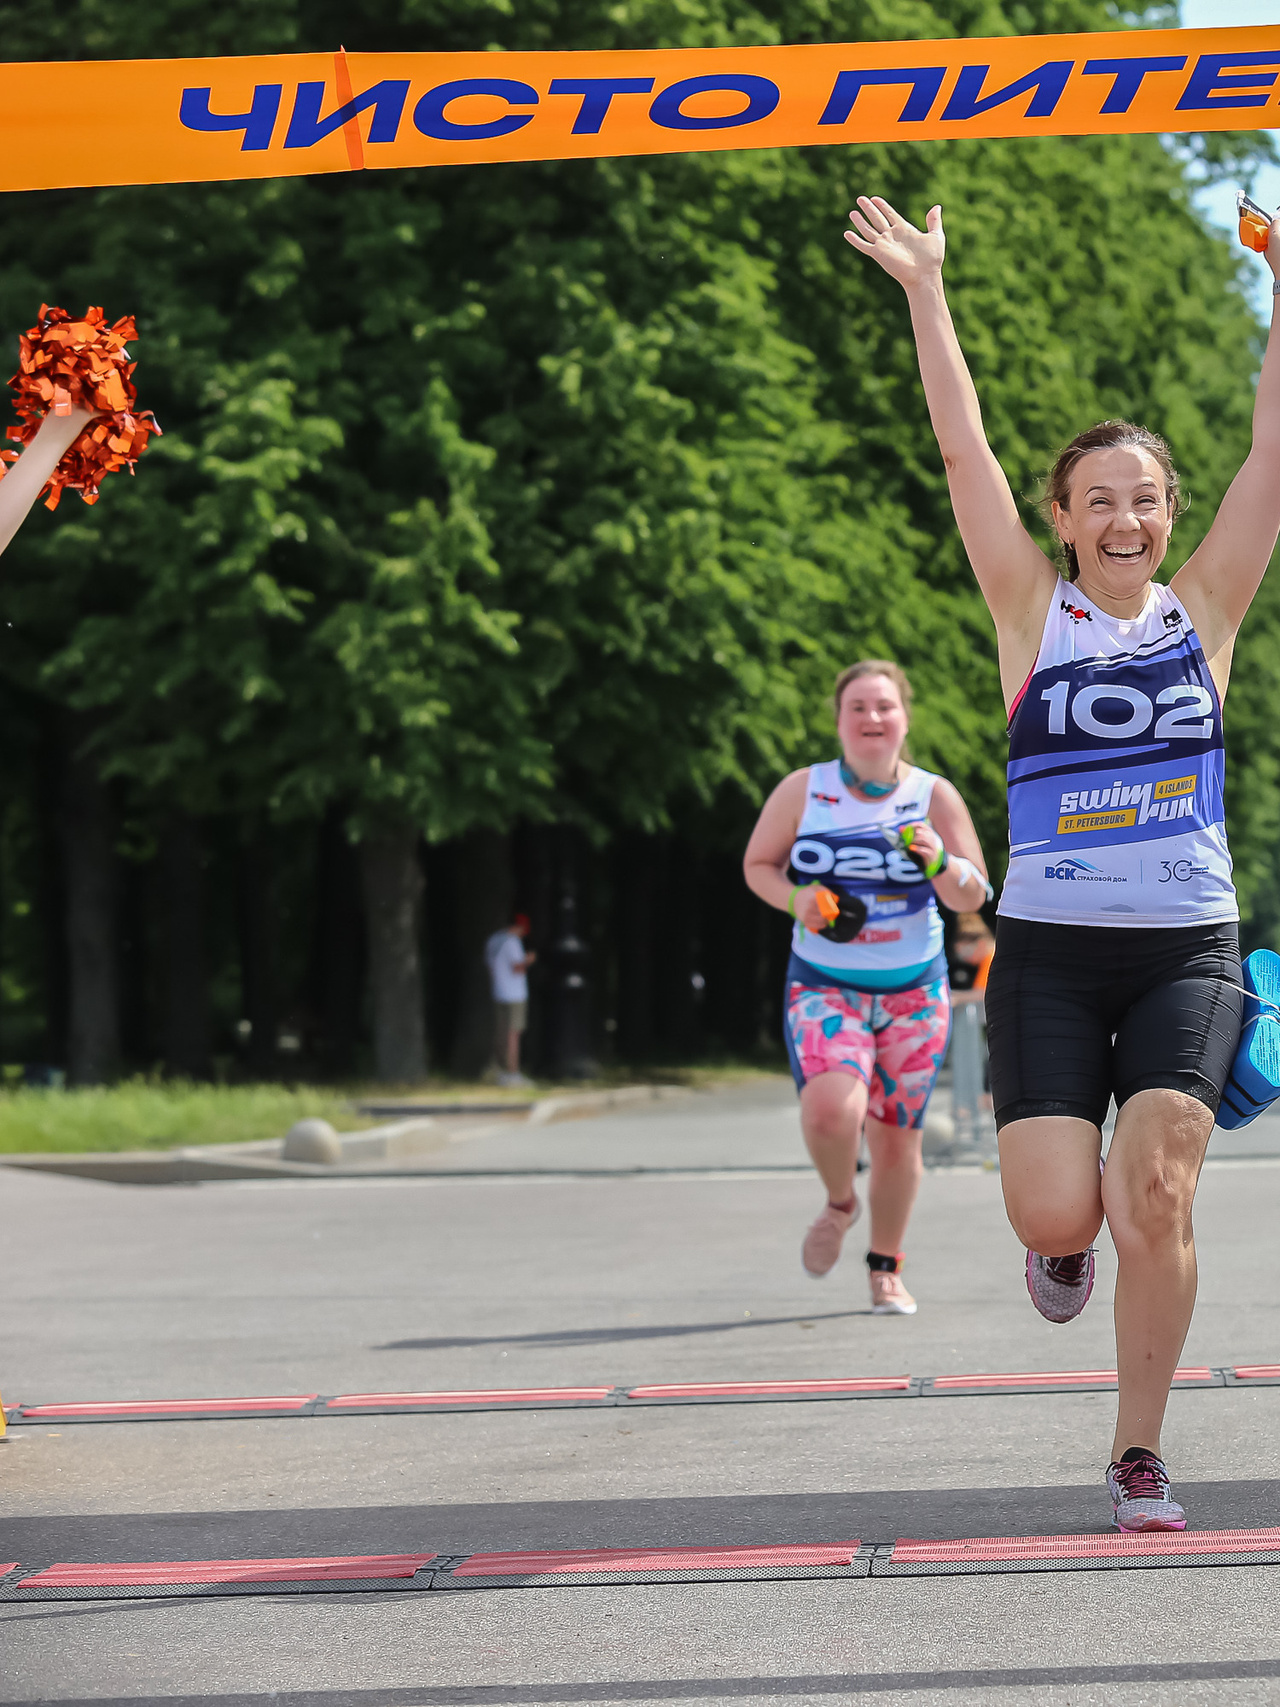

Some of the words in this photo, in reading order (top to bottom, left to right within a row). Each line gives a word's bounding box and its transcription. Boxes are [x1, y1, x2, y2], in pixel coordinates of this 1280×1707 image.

[179, 73, 779, 151] ЧИСТО
[1040, 681, 1214, 739] 102
[1165, 778, 1193, 793] ISLANDS
[1064, 819, 1075, 830] ST.
[1076, 813, 1127, 829] PETERSBURG
[1045, 866, 1077, 881] ВСК
[1077, 875, 1112, 884] СТРАХОВОЙ
[1112, 876, 1128, 884] ДОМ
